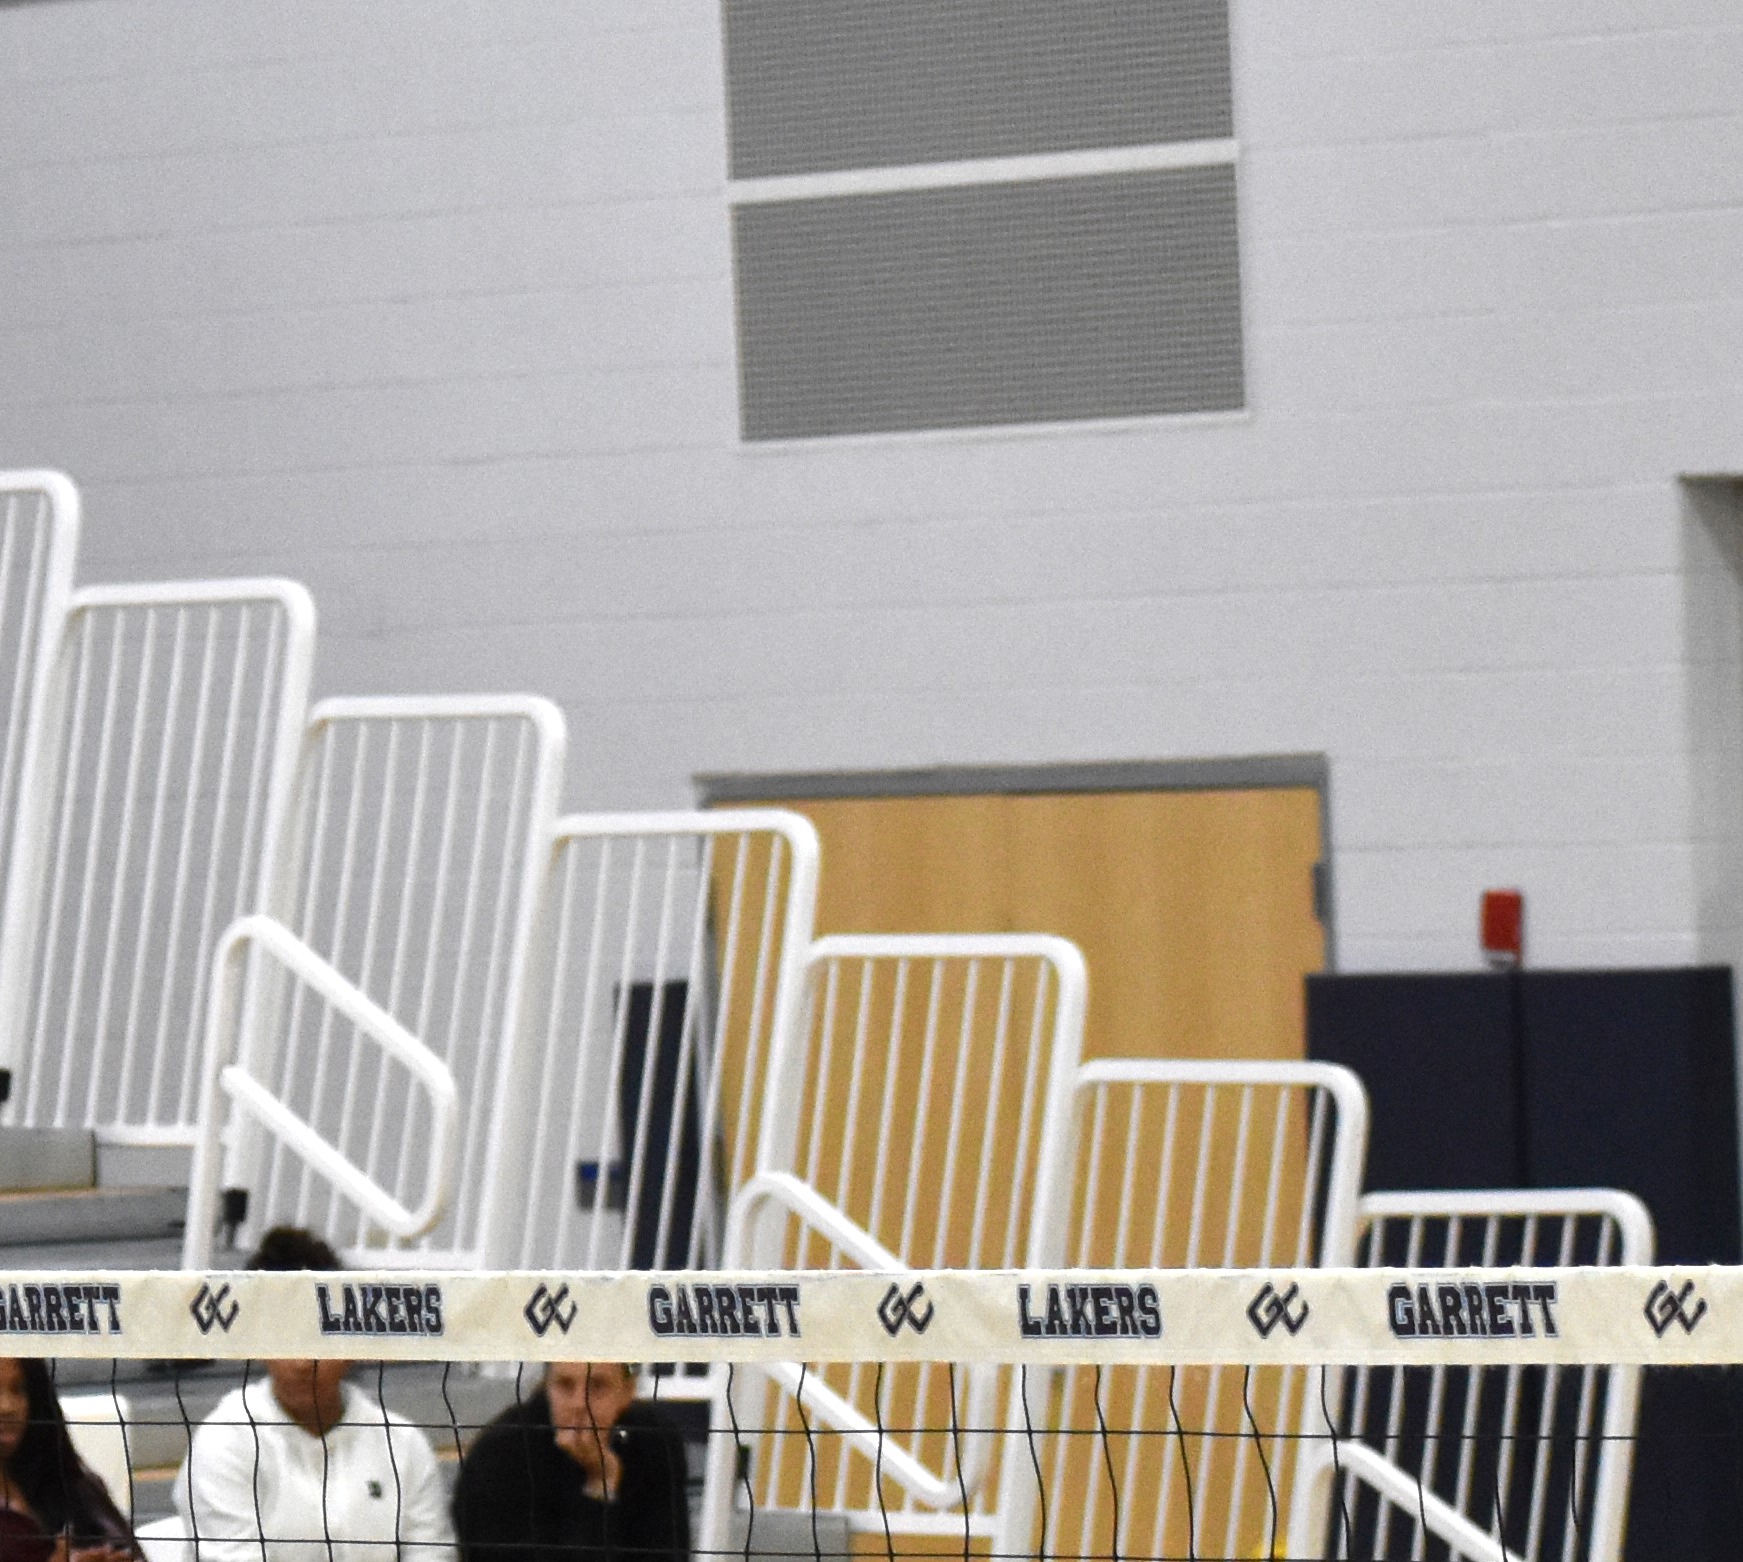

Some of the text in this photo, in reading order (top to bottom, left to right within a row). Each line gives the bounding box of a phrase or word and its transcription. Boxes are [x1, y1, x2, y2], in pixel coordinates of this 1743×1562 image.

[315, 1283, 447, 1340] LAKERS
[647, 1283, 804, 1341] GARRETT
[1017, 1283, 1165, 1341] LAKERS
[1386, 1280, 1560, 1342] GARRETT
